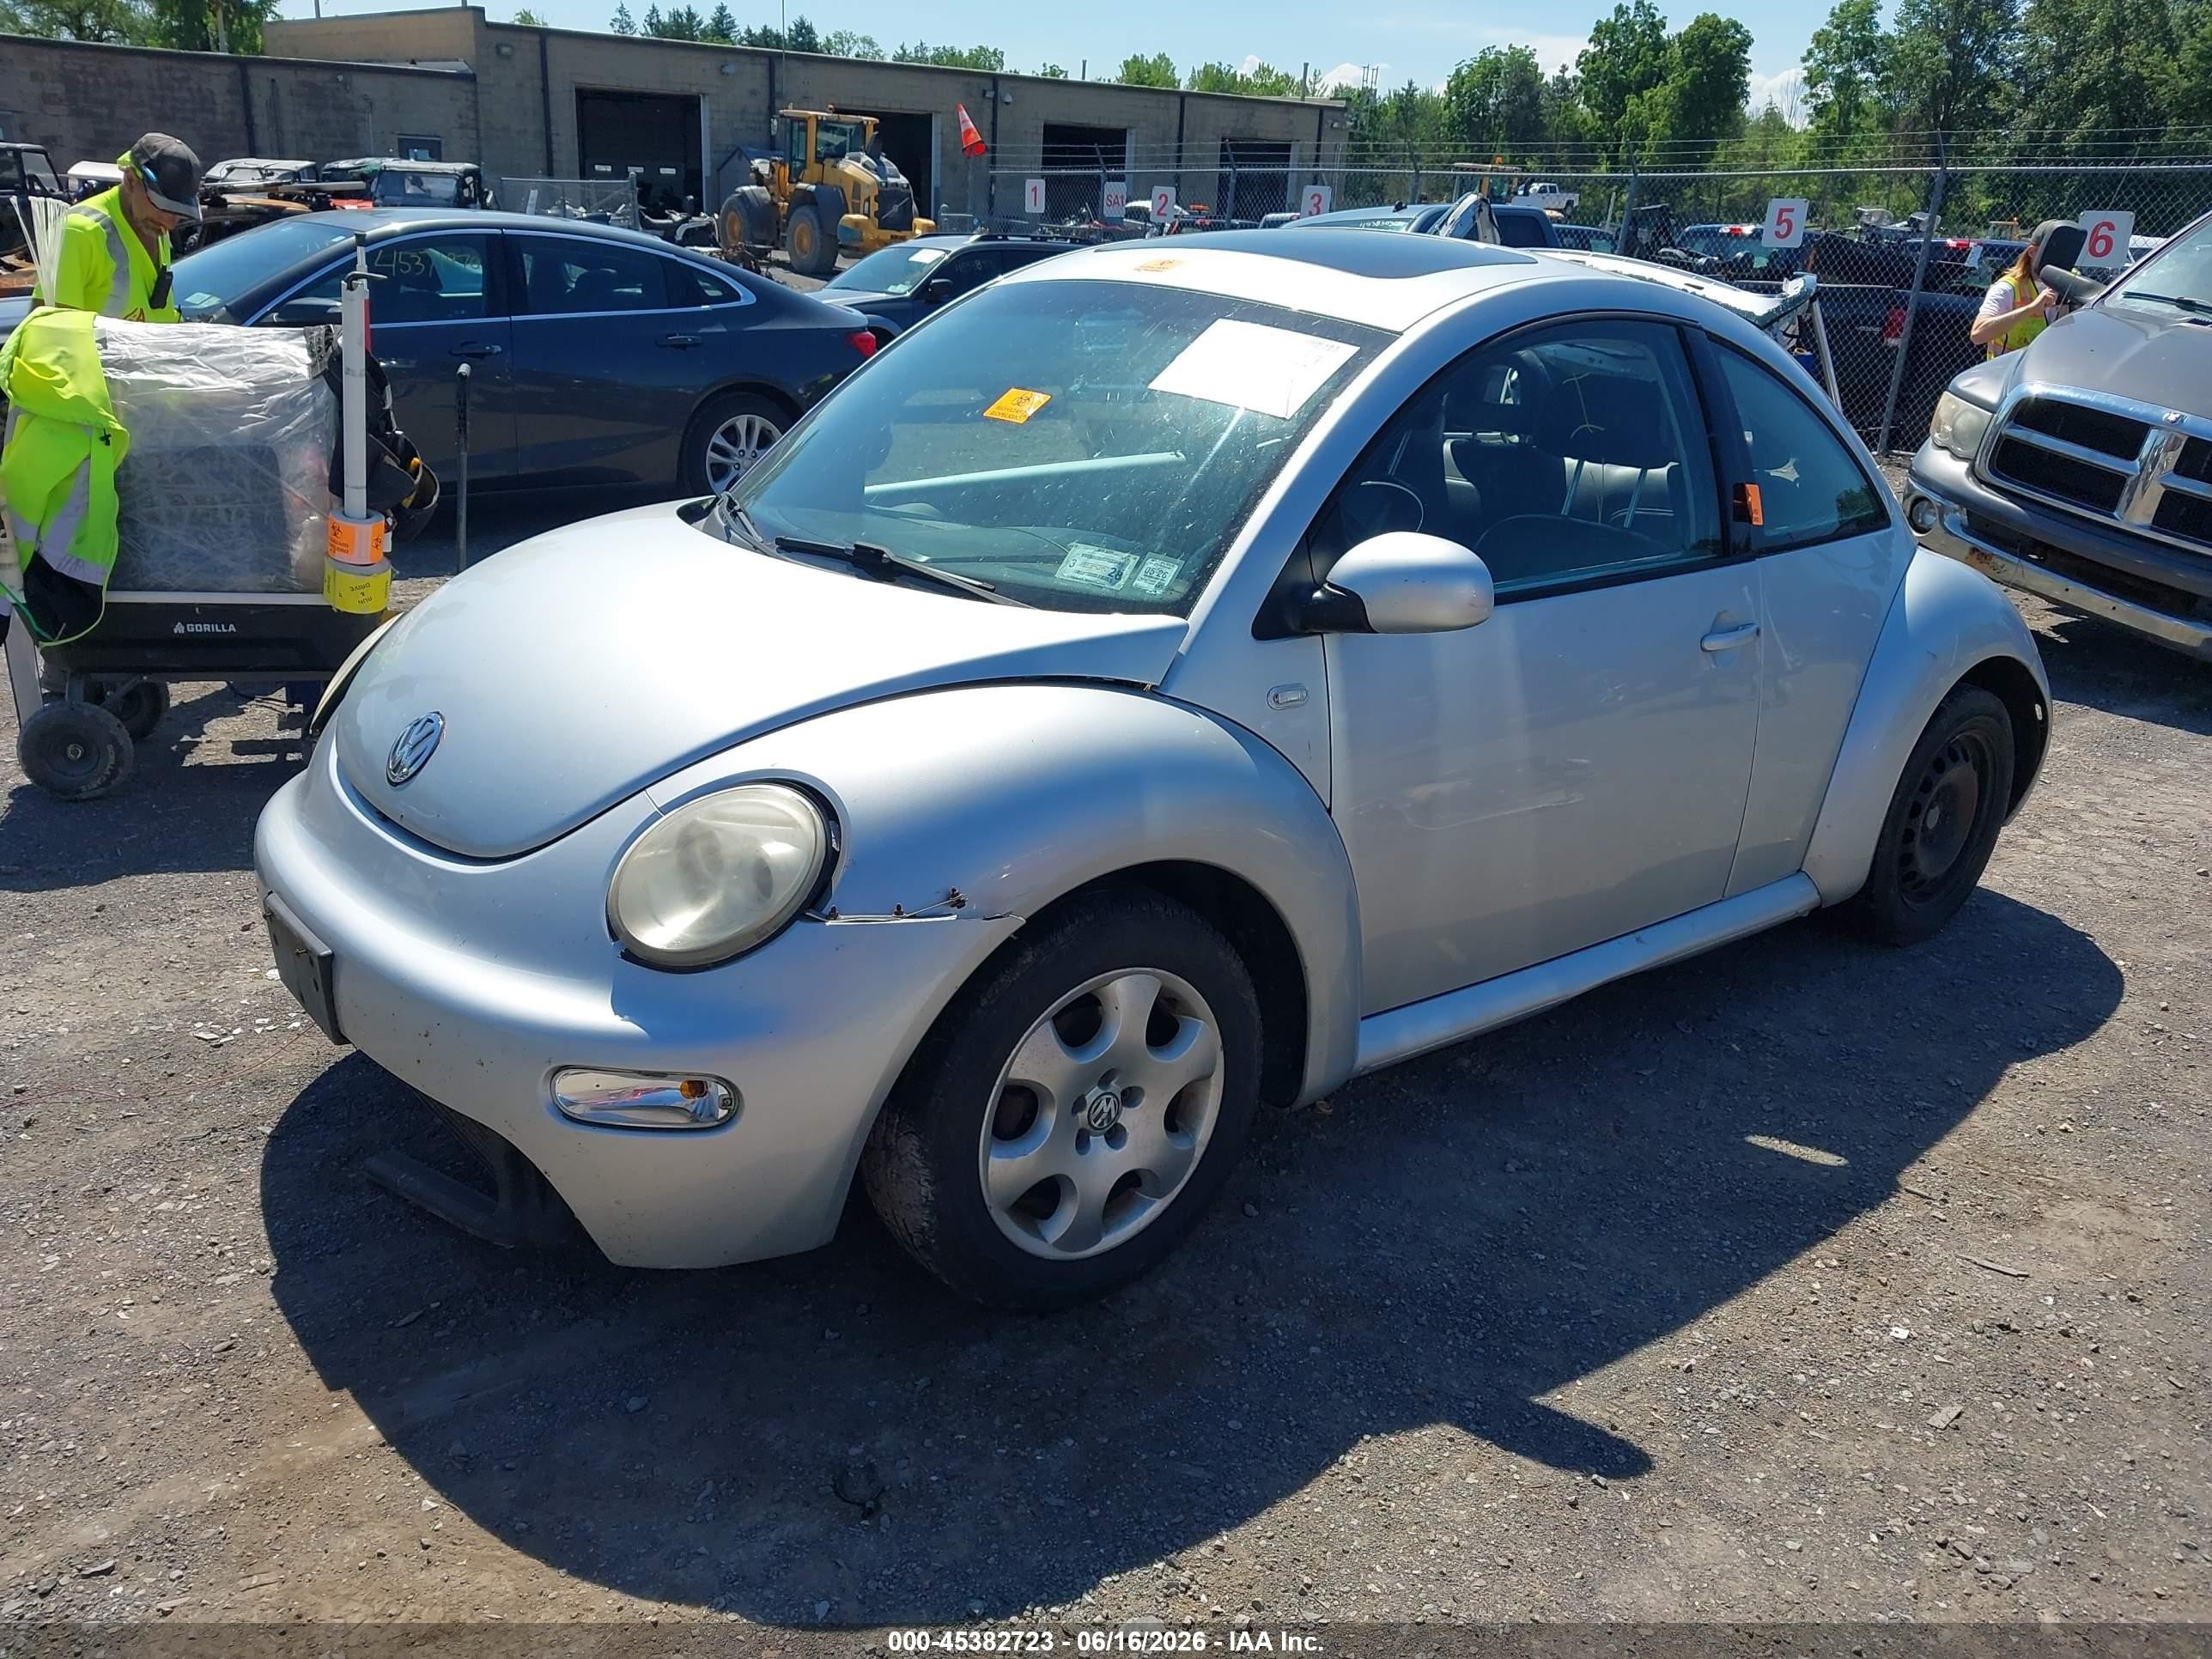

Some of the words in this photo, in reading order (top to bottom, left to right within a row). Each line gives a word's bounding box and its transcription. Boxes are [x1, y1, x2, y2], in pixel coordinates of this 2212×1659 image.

[1030, 185, 1038, 206] 1
[1156, 193, 1169, 216] 2
[1308, 192, 1322, 216] 3
[1774, 207, 1795, 239] 5
[2087, 221, 2116, 258] 6
[186, 623, 237, 632] GORILLA
